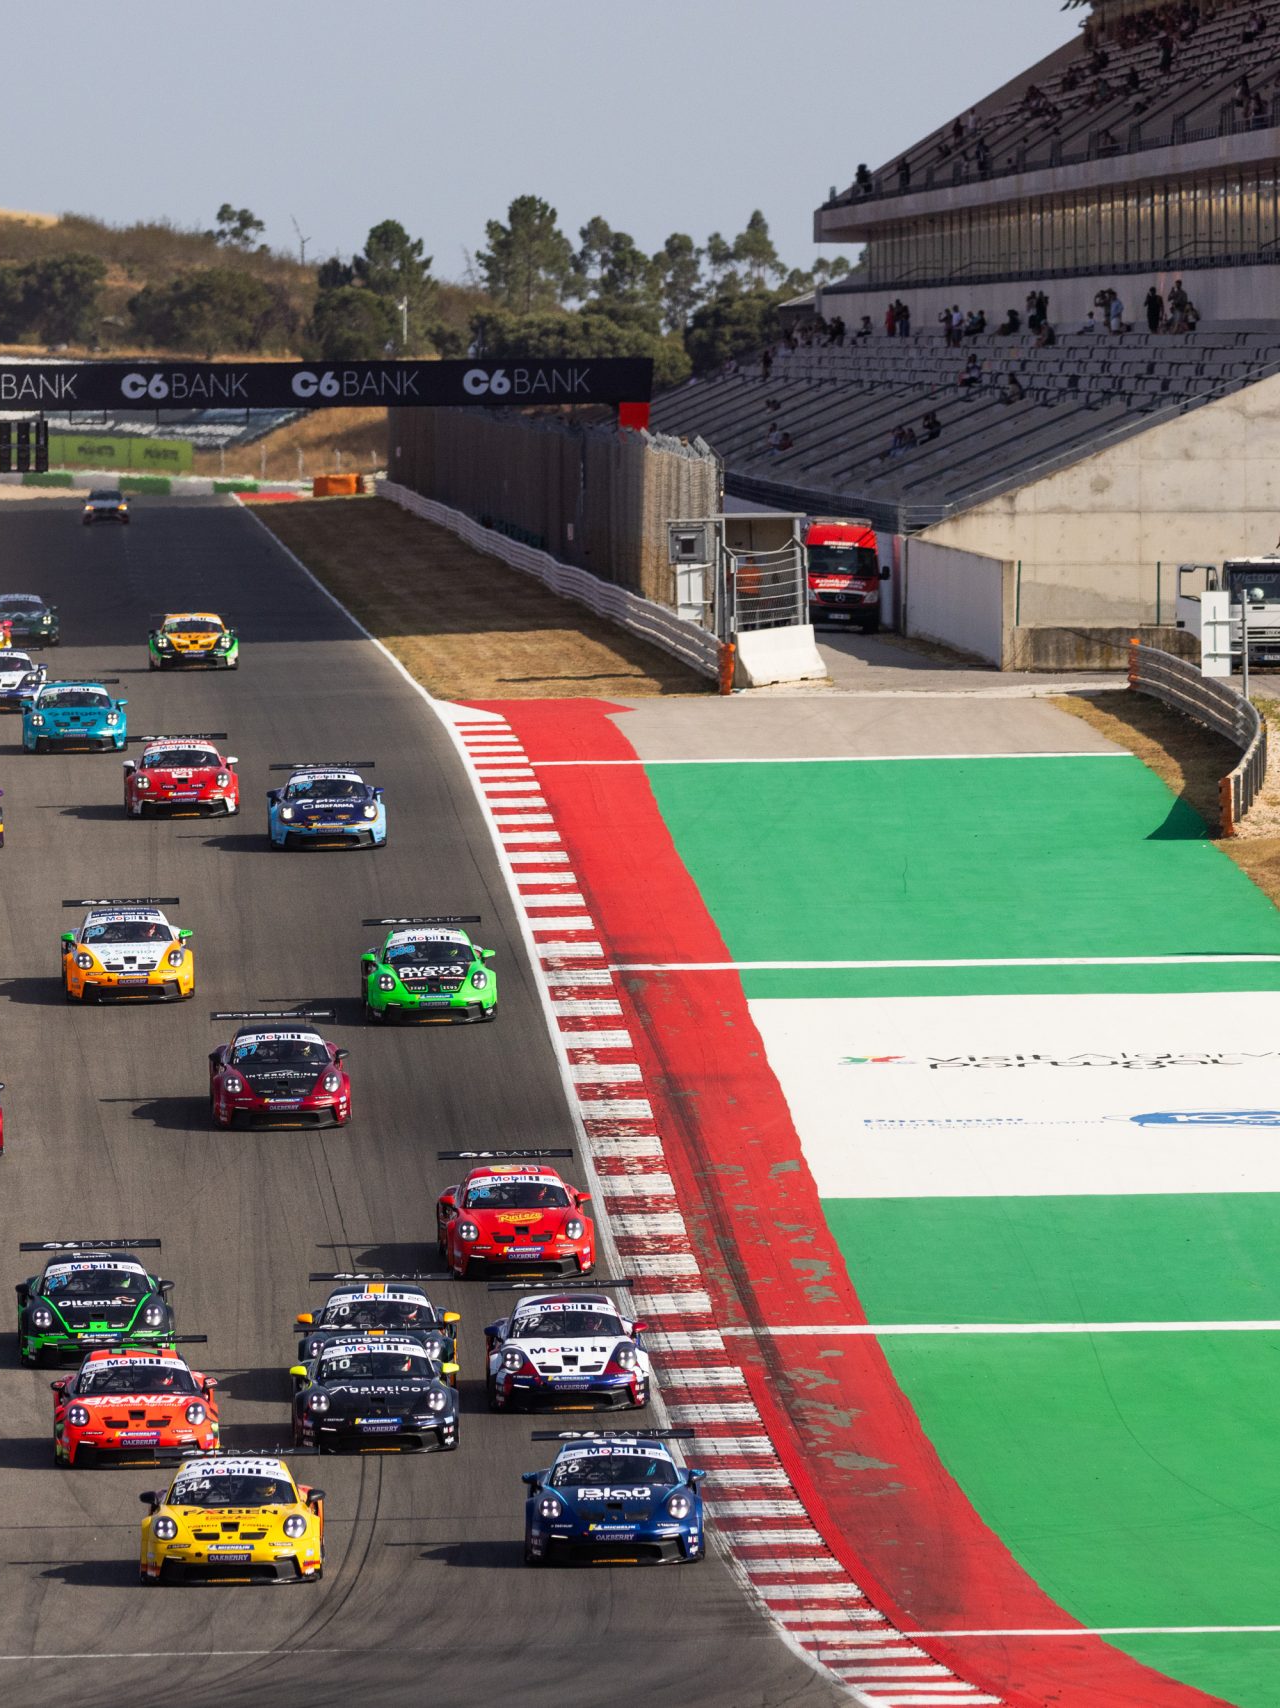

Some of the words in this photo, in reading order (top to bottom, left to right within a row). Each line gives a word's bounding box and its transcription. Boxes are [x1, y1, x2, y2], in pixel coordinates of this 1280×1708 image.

[47, 1275, 67, 1290] 21
[329, 1306, 350, 1319] 70
[540, 1304, 579, 1312] Mobil
[519, 1317, 540, 1330] 72
[335, 1336, 410, 1344] Kingspan
[328, 1359, 351, 1371] 10
[86, 1374, 96, 1385] 7
[186, 1460, 278, 1469] PARAFLU
[556, 1463, 580, 1477] 26
[202, 1467, 245, 1475] Mobil
[209, 1554, 249, 1562] OAKBERRY
